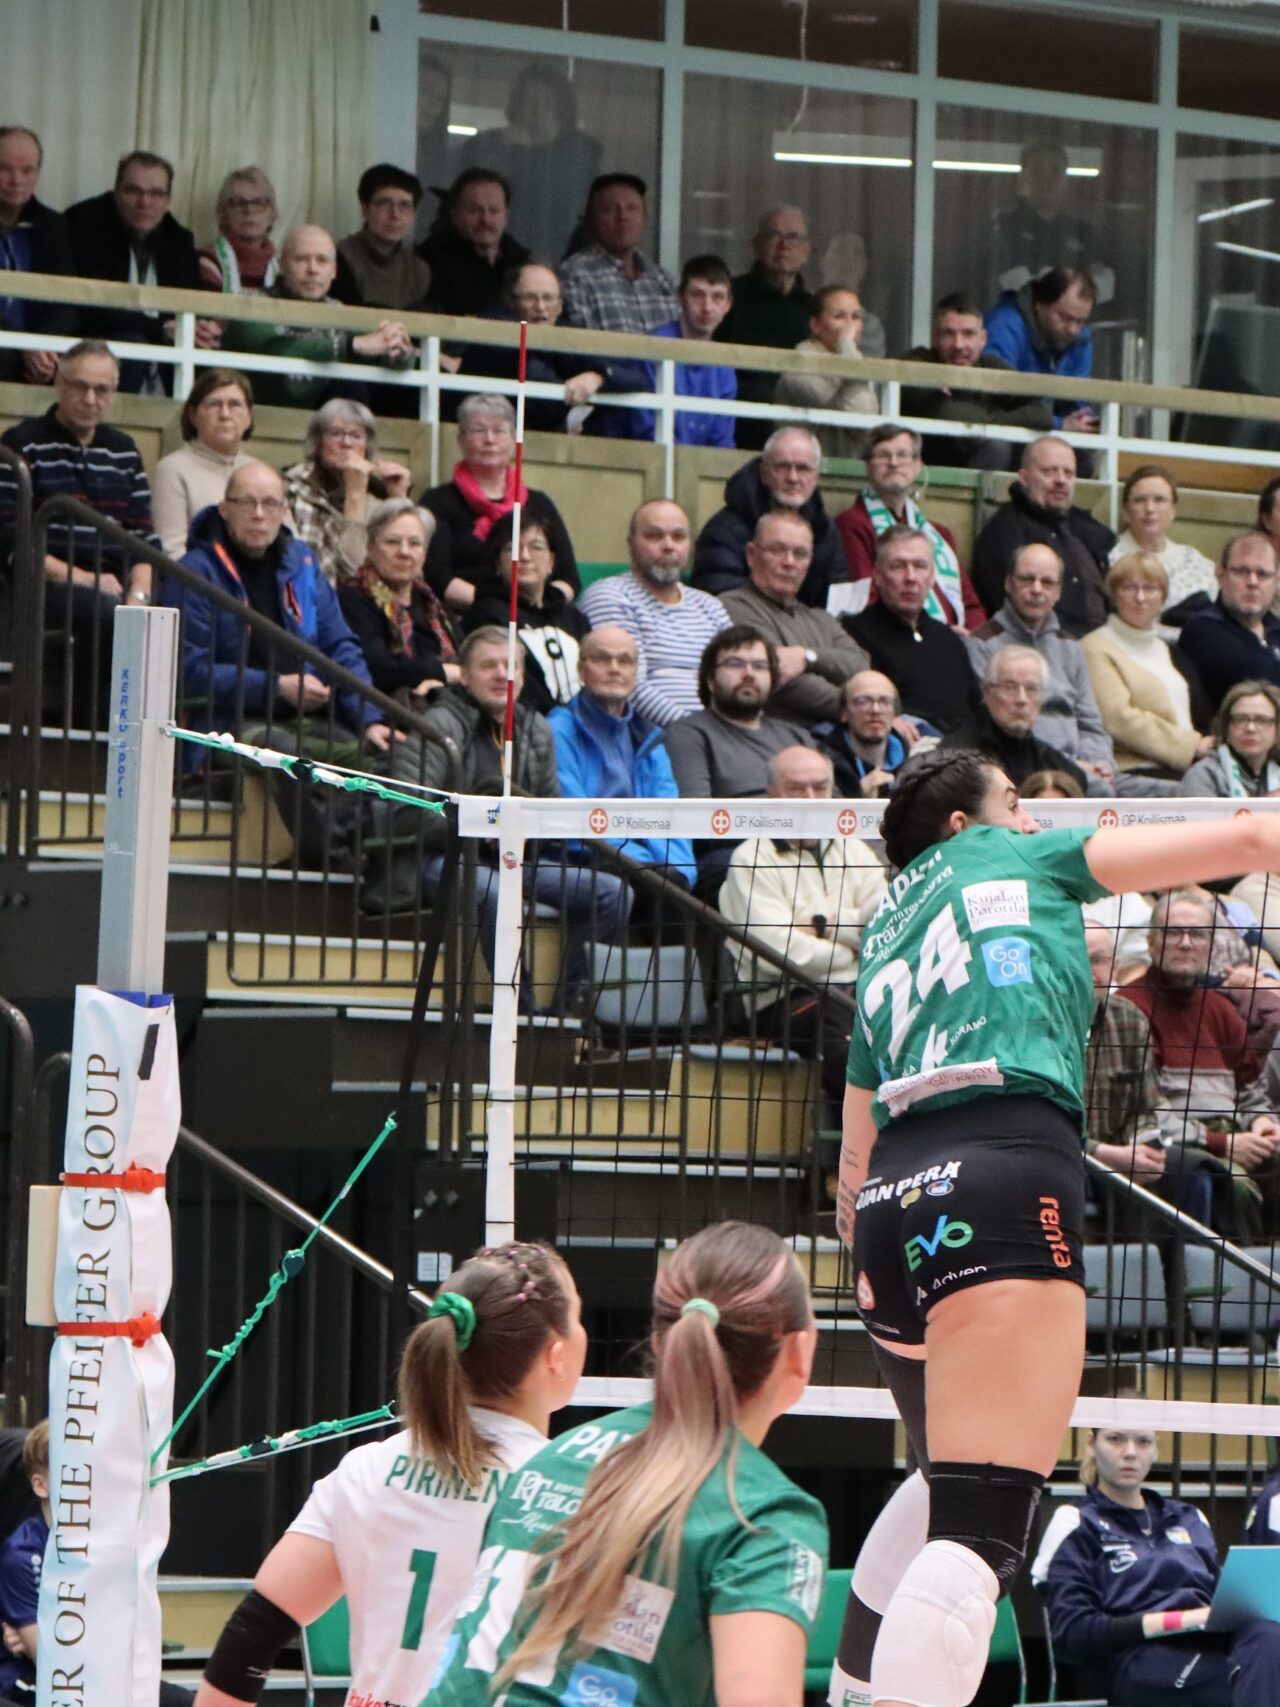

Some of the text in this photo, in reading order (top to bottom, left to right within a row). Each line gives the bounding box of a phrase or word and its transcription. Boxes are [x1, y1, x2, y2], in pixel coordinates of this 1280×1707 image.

[612, 814, 671, 830] OP Koillismaa
[734, 814, 794, 829] OP Koillismaa
[1122, 814, 1136, 827] OP
[967, 891, 1025, 907] Kujalan
[969, 901, 1027, 919] Porotila
[990, 944, 1020, 962] Go
[1001, 960, 1028, 979] On
[864, 902, 973, 1065] 24
[904, 1215, 974, 1272] EVO
[1039, 1196, 1073, 1268] renta
[56, 1464, 93, 1565] THE
[401, 1548, 437, 1651] 1
[54, 1581, 86, 1646] OF
[576, 1674, 618, 1702] Go
